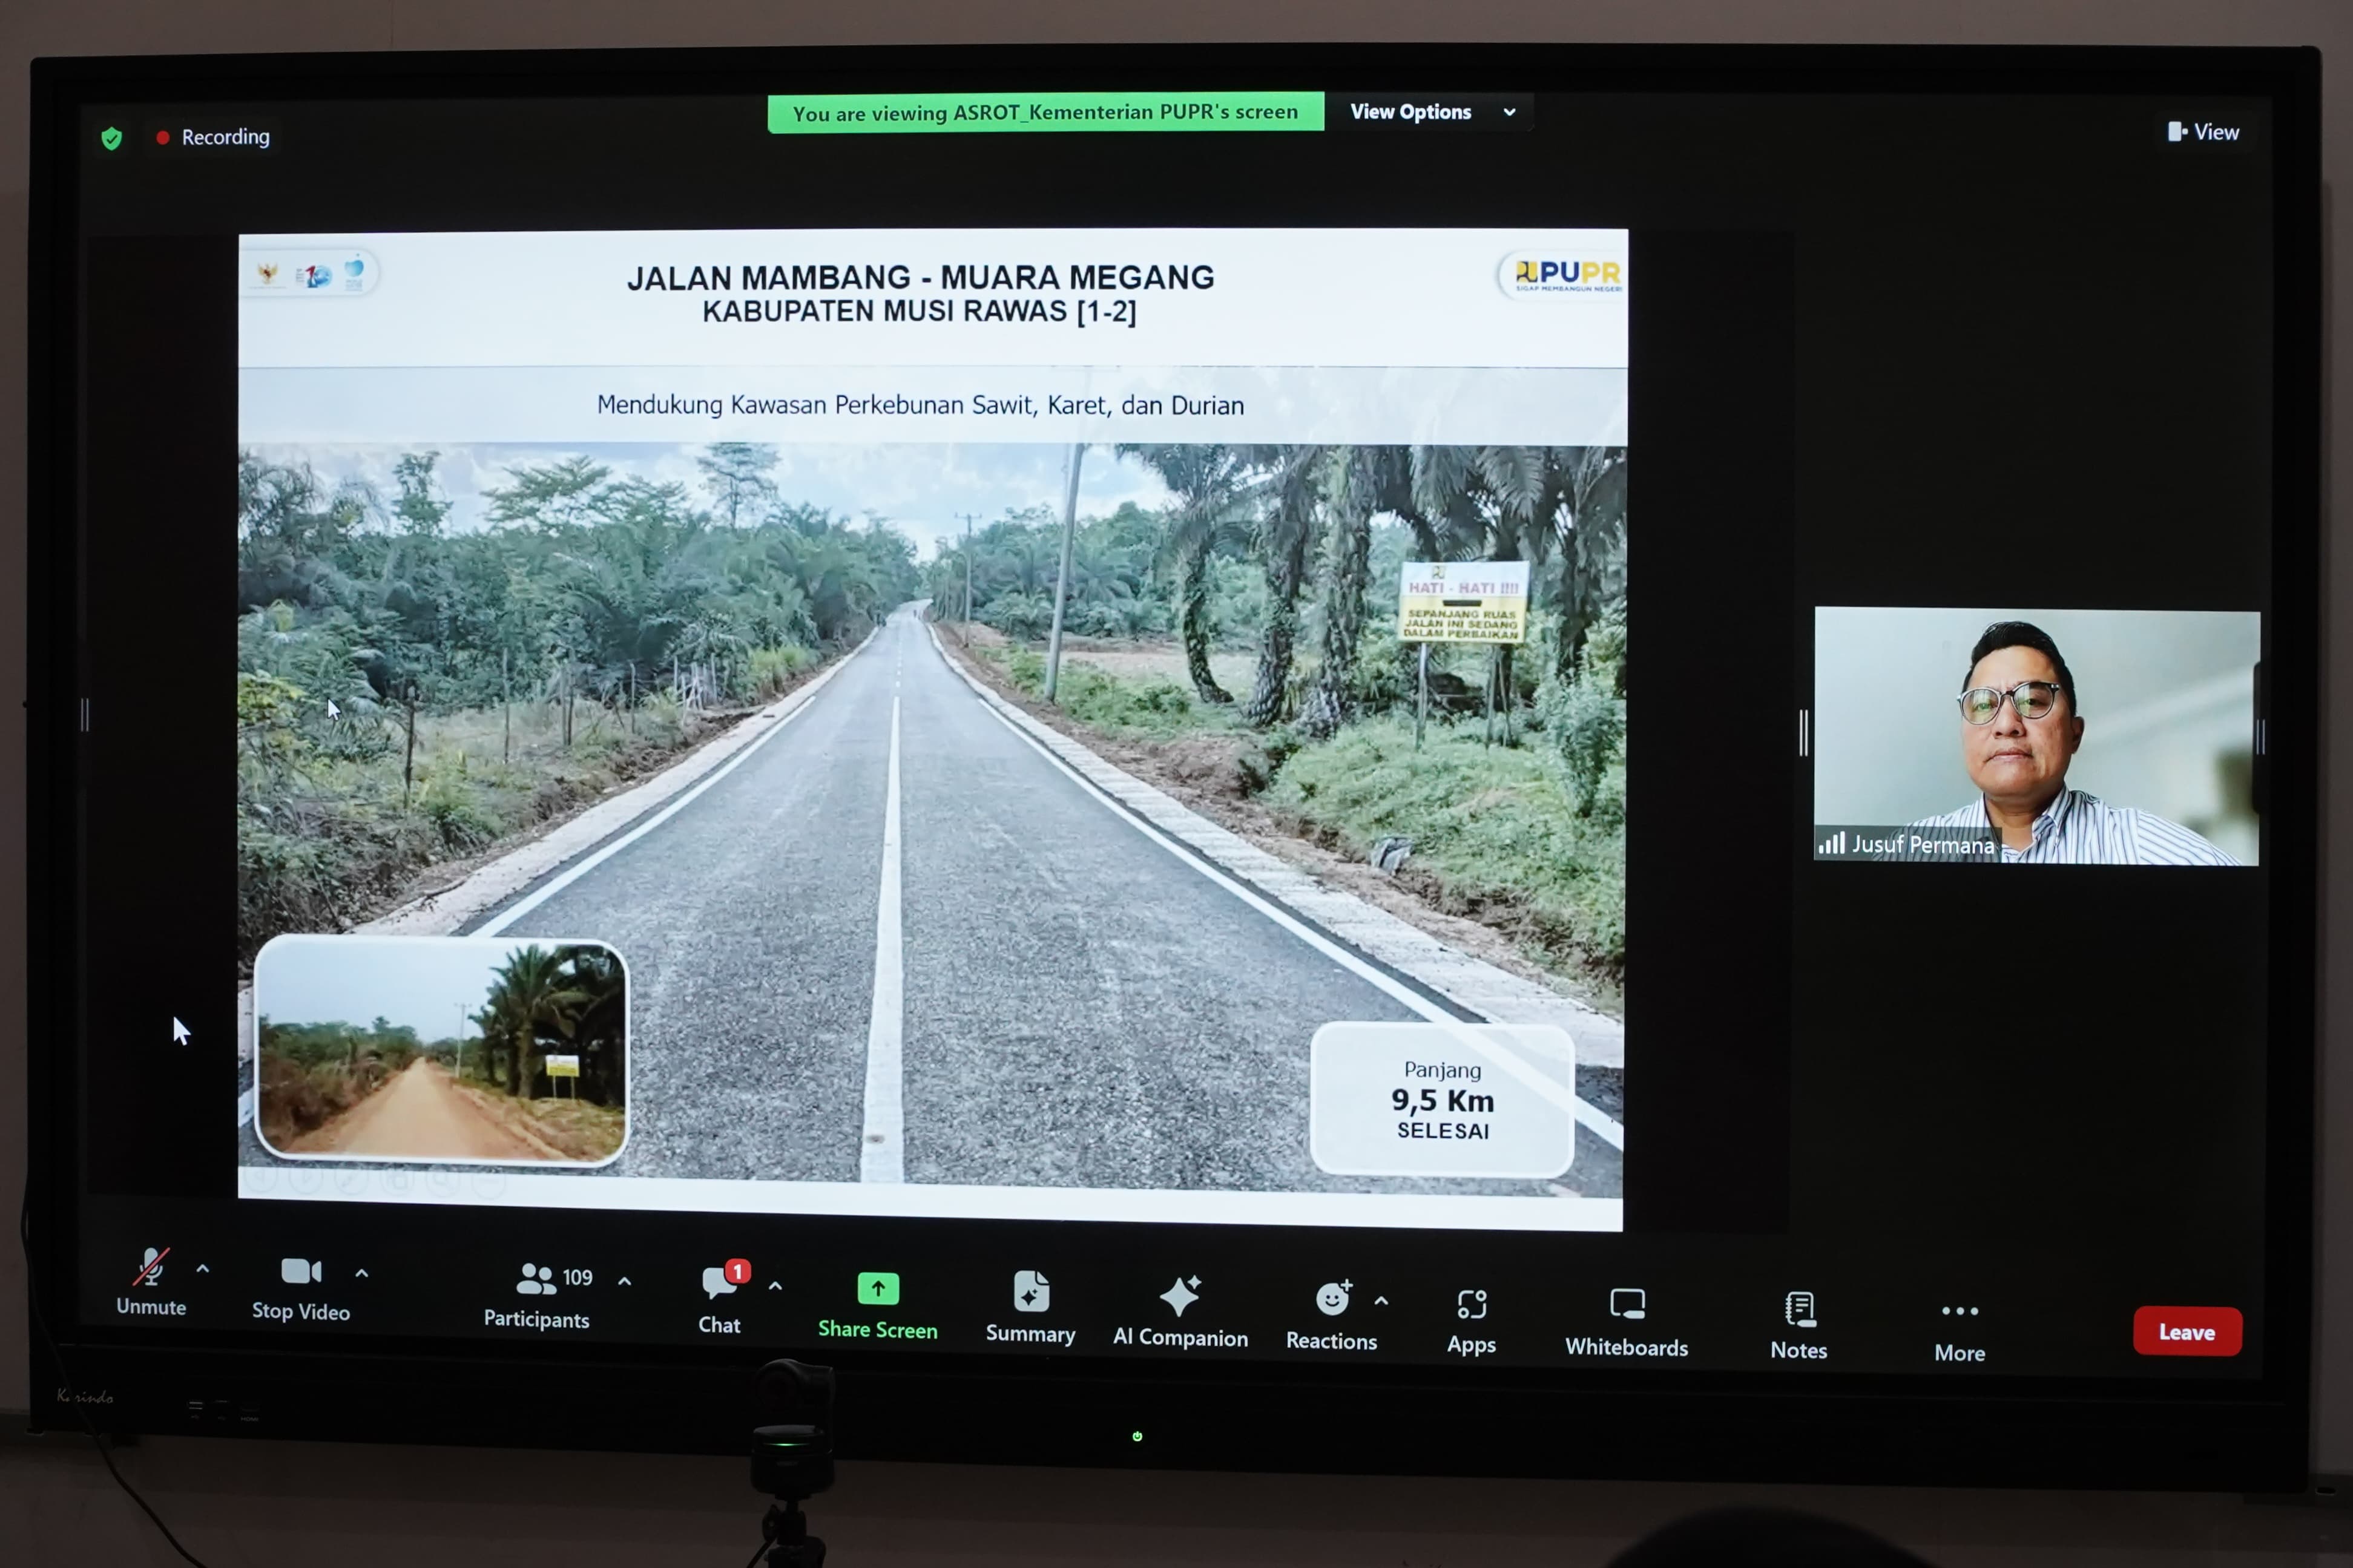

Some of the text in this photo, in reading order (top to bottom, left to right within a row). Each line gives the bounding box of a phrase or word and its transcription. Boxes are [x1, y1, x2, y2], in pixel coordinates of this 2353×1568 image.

[793, 103, 1298, 125] You are viewing ASROT_Kementerian PUPR's screen
[1351, 102, 1472, 124] View Options
[183, 127, 270, 149] Recording
[2194, 122, 2240, 140] View
[627, 266, 731, 291] JALAN
[743, 264, 910, 290] MAMBANG
[942, 264, 1061, 290] MUARA
[1070, 264, 1214, 290] MEGANG
[1541, 261, 1621, 284] PUPR
[703, 299, 1136, 329] KABUPATEN MUSI RAWAS [1-2]
[598, 393, 1244, 419] Mendukung Kawasan Perkebunan Sawit, Karet, dan Durian
[1409, 582, 1444, 594] HATI
[1459, 582, 1495, 594] HATI
[1405, 619, 1443, 628] JALAN
[1468, 620, 1518, 629] SEDANG
[1408, 609, 1516, 619] SEPANJANG RUAS
[1403, 629, 1519, 640] DALAM PERBAIKAN
[1852, 834, 1995, 855] Jusuf Permana
[1405, 1061, 1481, 1083] Panjang
[1392, 1088, 1494, 1118] 9,5 Km
[1398, 1122, 1489, 1140] SELESAI
[563, 1268, 593, 1286] 109
[734, 1264, 742, 1280] 1
[117, 1297, 186, 1316] Unmute
[252, 1301, 350, 1324] Stop Video
[485, 1309, 590, 1332] Participants
[699, 1316, 741, 1334] Chat
[818, 1319, 938, 1339] Share Screen
[987, 1324, 1076, 1347] Summary
[1113, 1327, 1248, 1351] AI Companion
[1287, 1331, 1378, 1350] Reactions
[2159, 1323, 2216, 1341] Leave
[1447, 1335, 1496, 1357] Apps
[1565, 1337, 1689, 1357] Whiteboards
[1771, 1341, 1828, 1359] Notes
[1935, 1343, 1986, 1362] More
